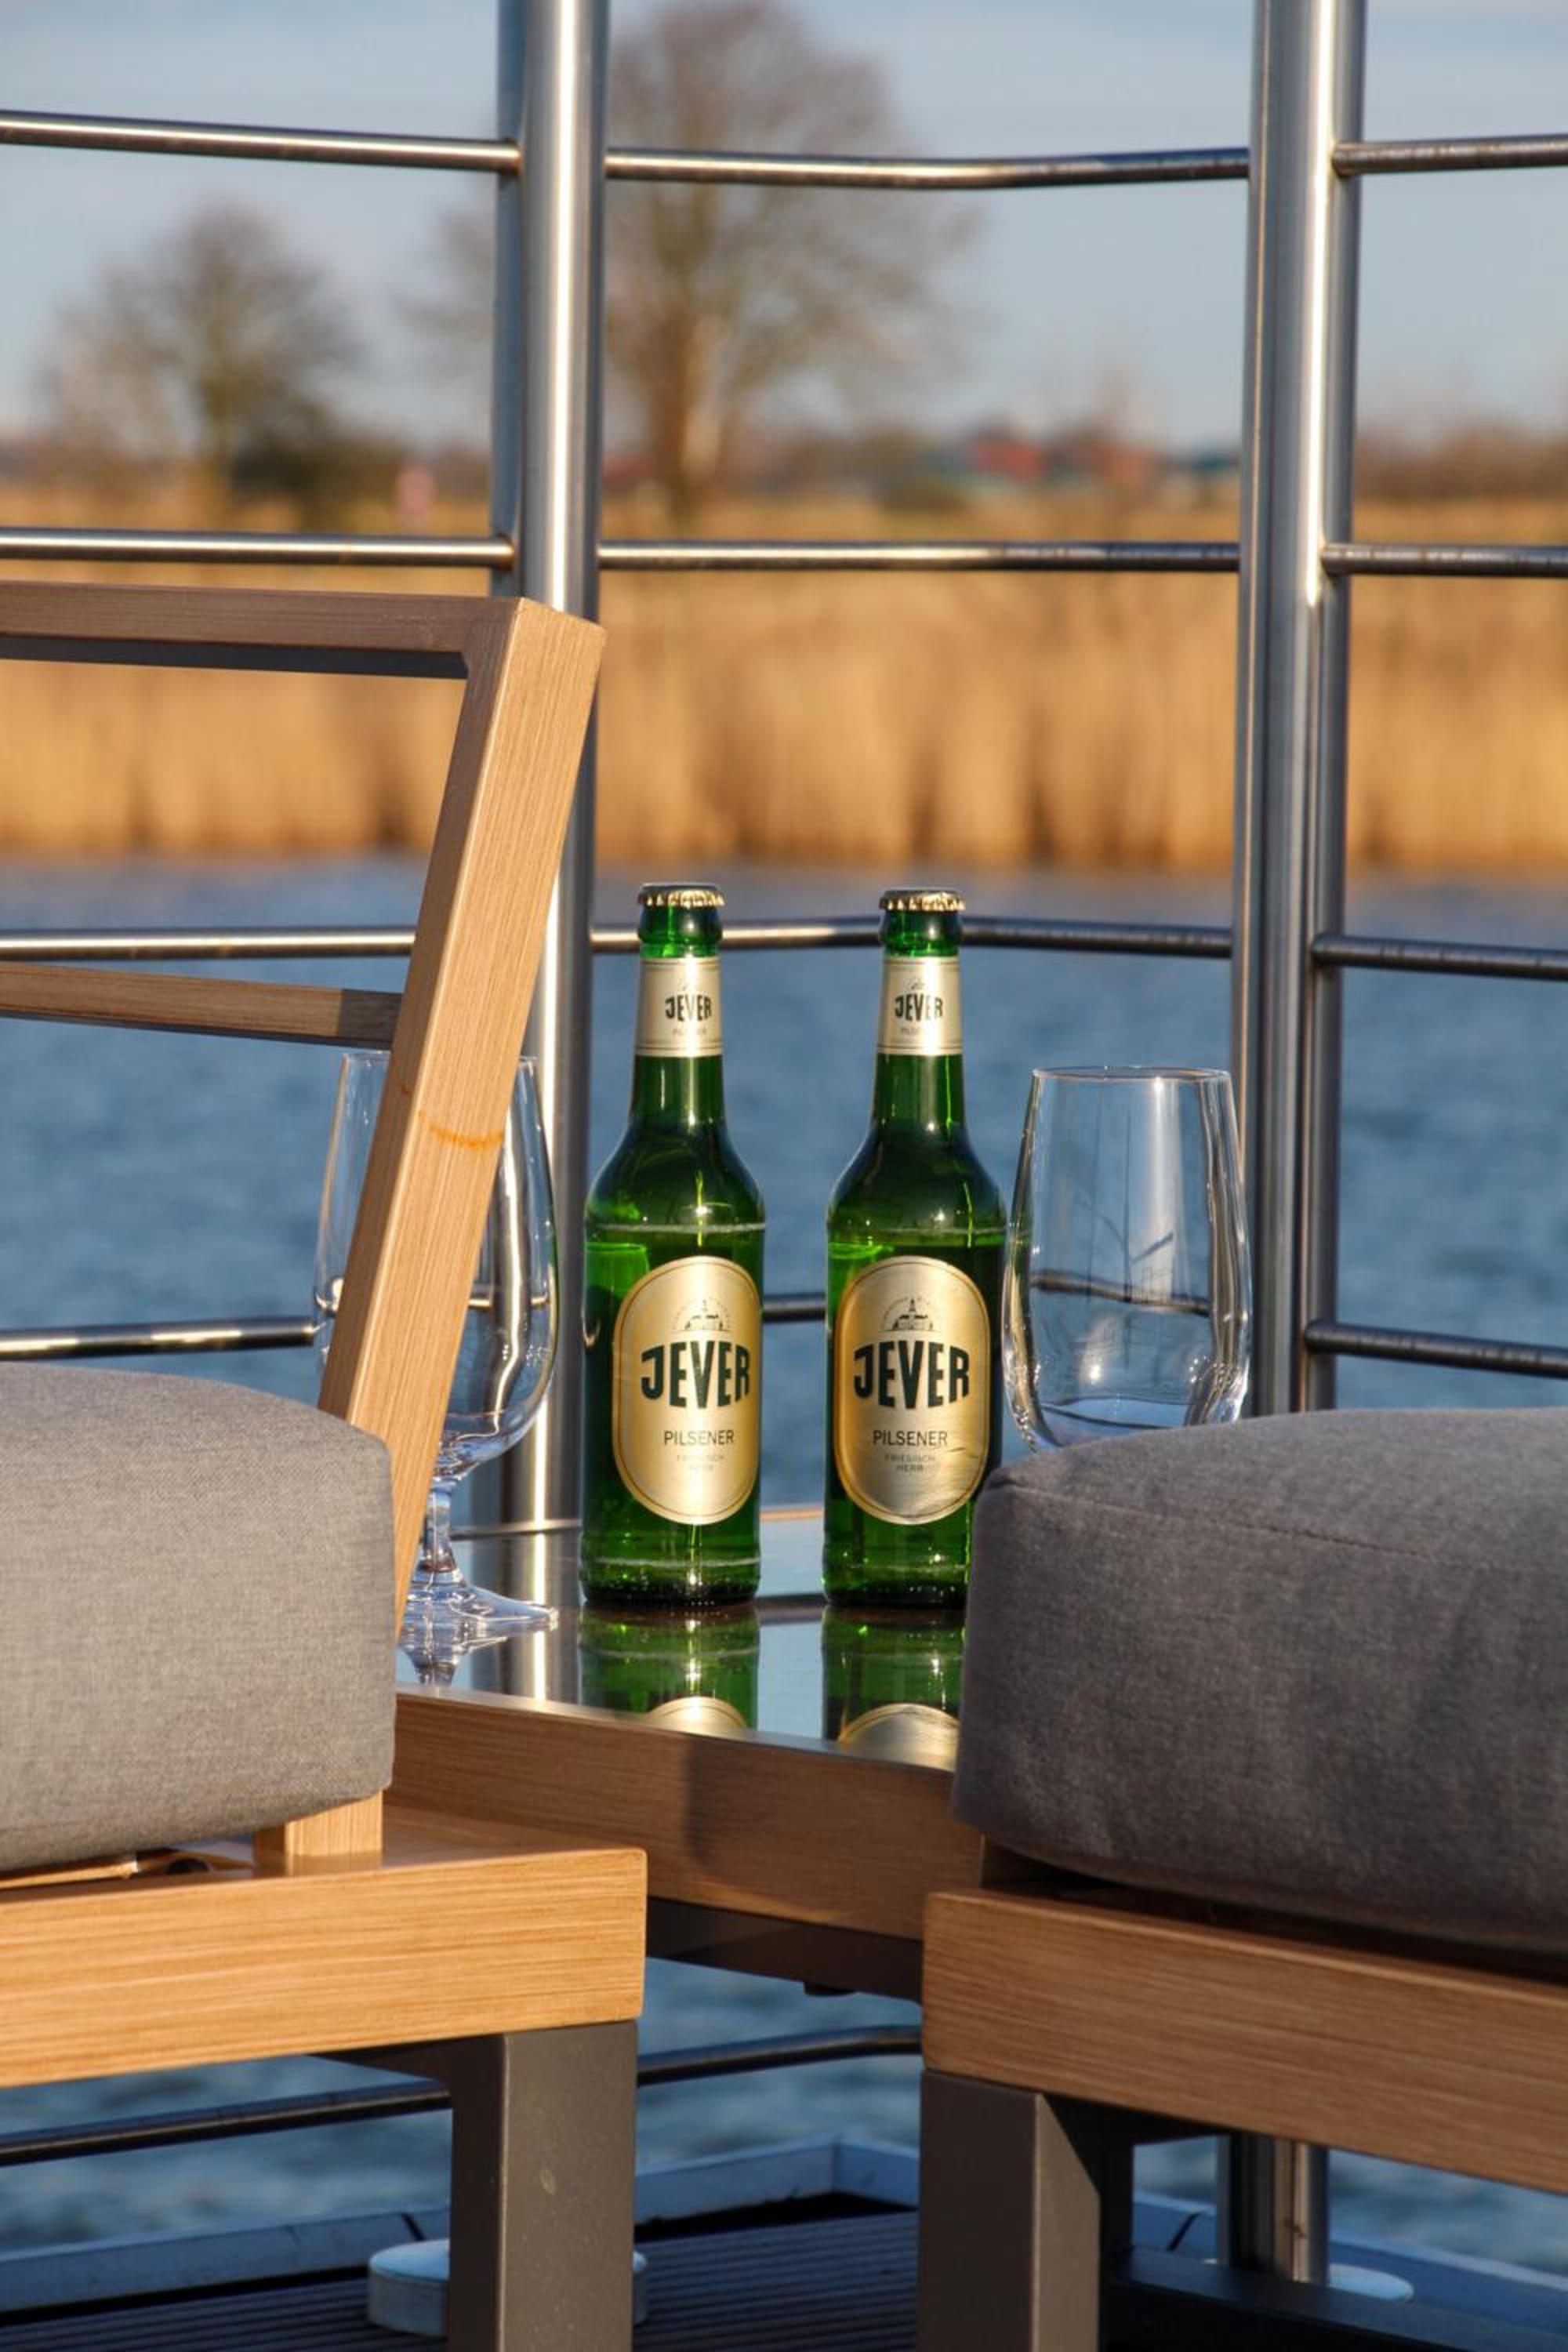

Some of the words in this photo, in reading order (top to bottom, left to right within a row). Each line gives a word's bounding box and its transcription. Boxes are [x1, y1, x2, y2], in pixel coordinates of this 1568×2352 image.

[665, 993, 713, 1022] JEVER
[894, 993, 944, 1022] JEVER
[641, 1340, 751, 1410] JEVER
[853, 1340, 971, 1410] JEVER
[663, 1429, 735, 1446] PILSENER
[872, 1429, 948, 1446] PILSENER
